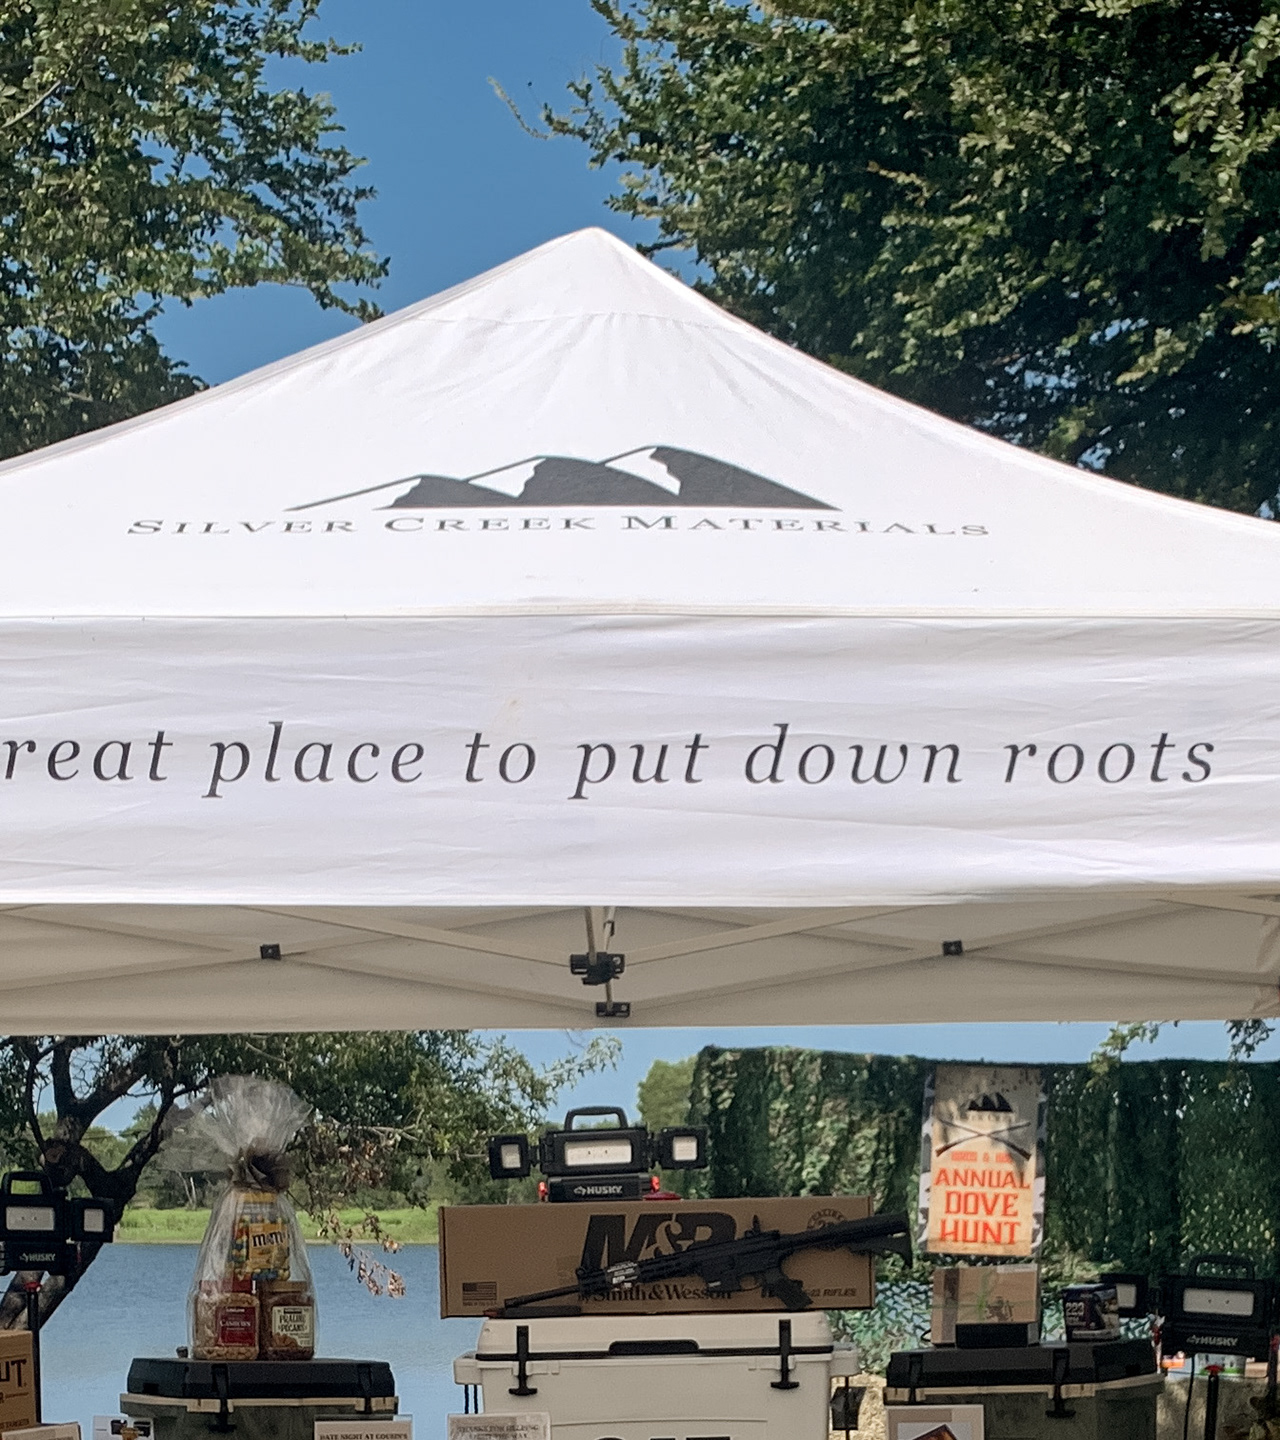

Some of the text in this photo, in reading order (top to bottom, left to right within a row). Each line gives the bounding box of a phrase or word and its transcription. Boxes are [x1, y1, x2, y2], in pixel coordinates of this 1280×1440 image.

[127, 514, 991, 536] SILVER CREEK MATERIALS
[201, 721, 425, 799] place
[464, 731, 537, 783] to
[567, 732, 709, 800] put
[745, 723, 961, 785] down
[1003, 732, 1214, 784] roots
[587, 1185, 622, 1195] HUSKY
[934, 1168, 1031, 1190] ANNUAL
[945, 1191, 1018, 1217] DOVE
[939, 1218, 1021, 1245] HUNT
[29, 1253, 55, 1262] HUSKY
[823, 1288, 857, 1297] RIFLES
[1199, 1337, 1237, 1346] HUSKY
